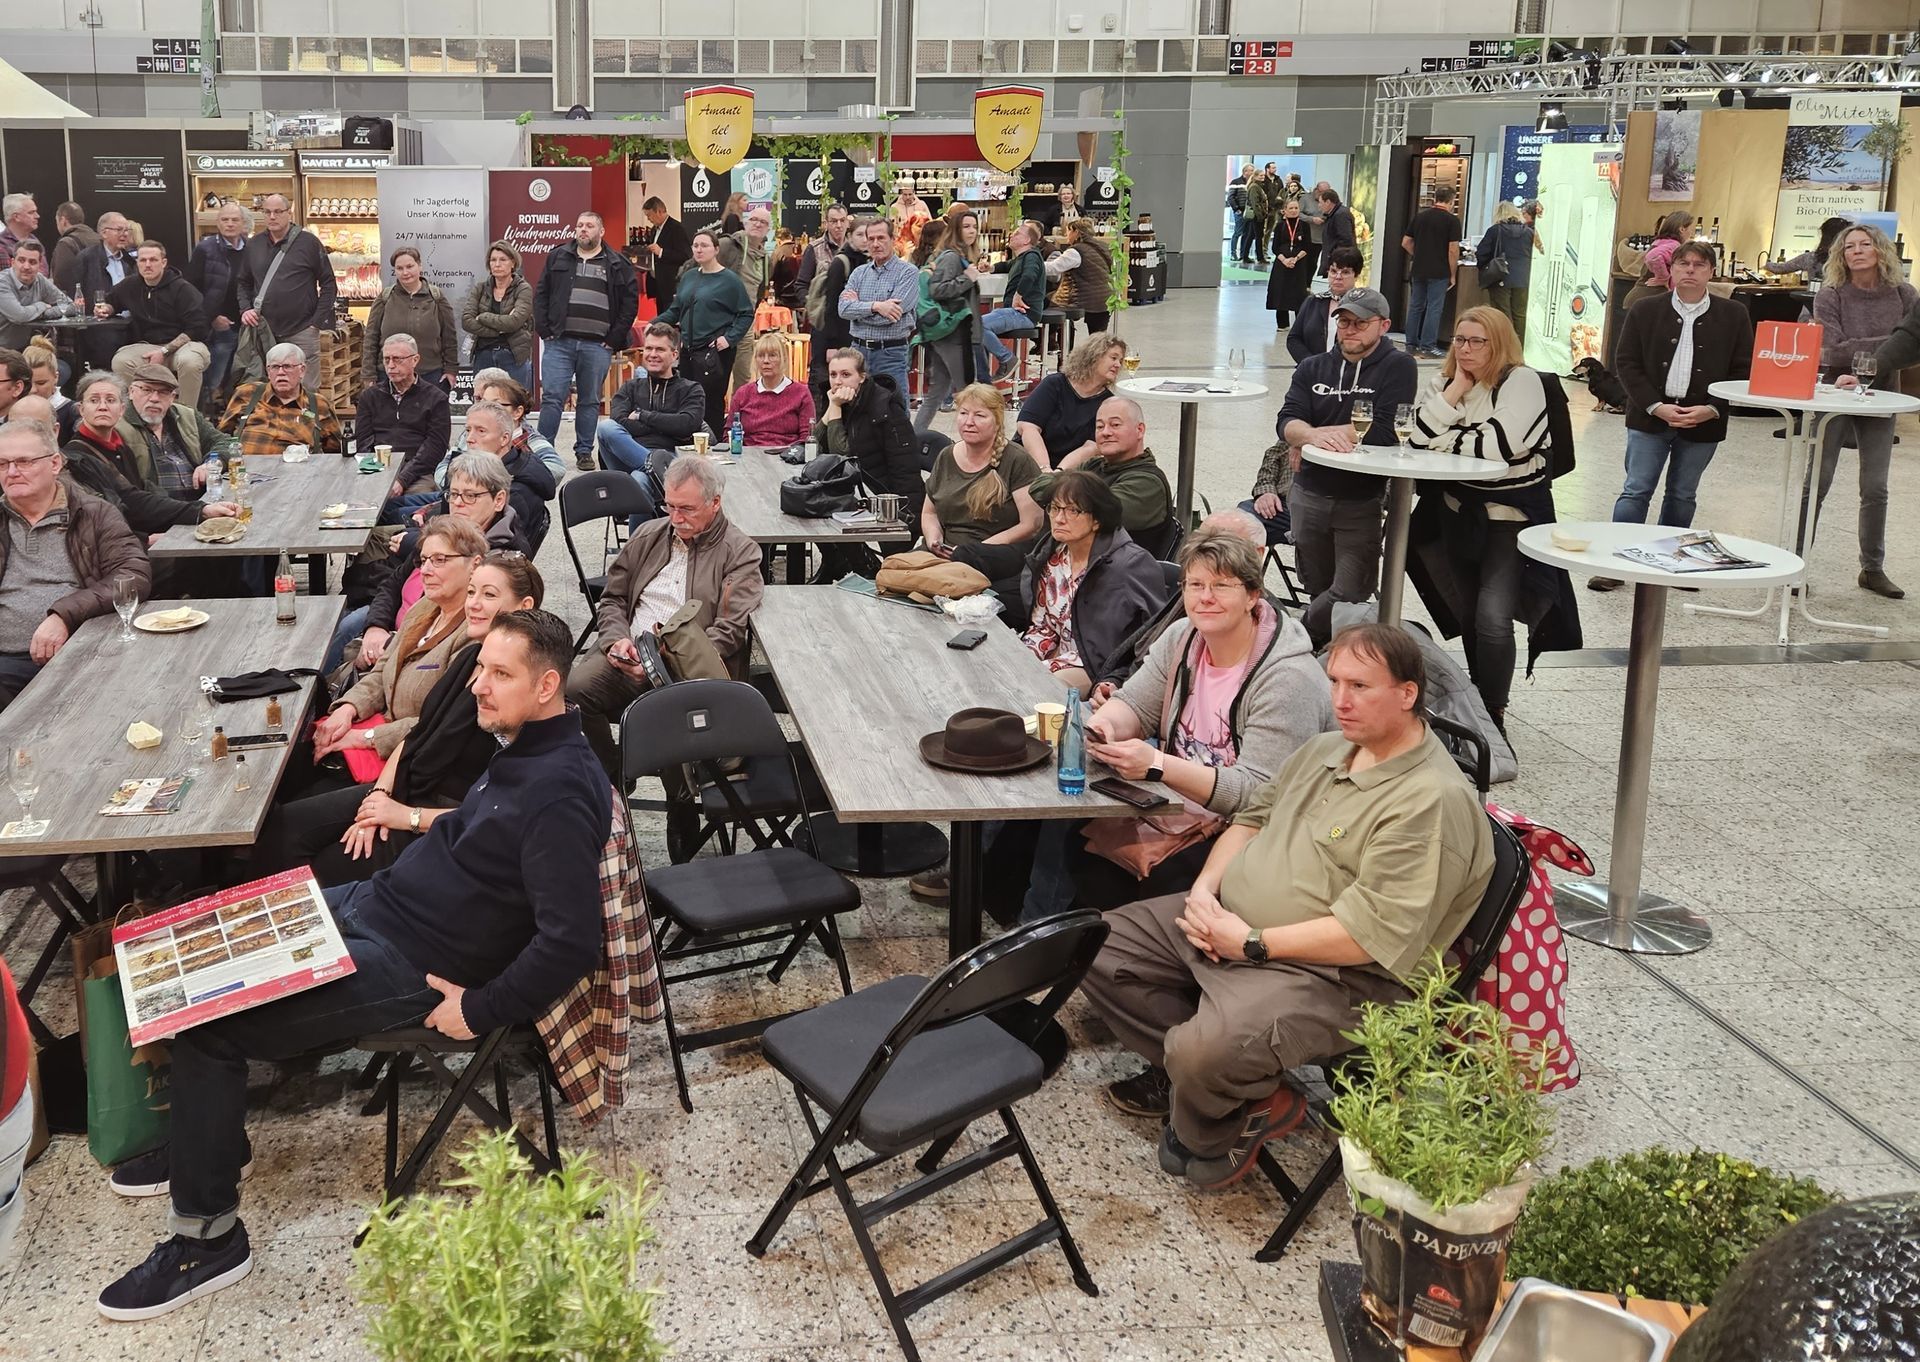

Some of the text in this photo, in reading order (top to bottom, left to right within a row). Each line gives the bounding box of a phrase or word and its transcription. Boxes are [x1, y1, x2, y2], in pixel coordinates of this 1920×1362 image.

[1249, 43, 1258, 56] 1
[1247, 60, 1273, 74] 2-8
[698, 103, 743, 116] Amanti
[988, 103, 1033, 117] Amanti
[711, 124, 730, 136] del
[1000, 124, 1020, 135] del
[1518, 135, 1554, 144] UNSERE
[706, 142, 732, 156] Vino
[995, 142, 1020, 155] Vino
[1516, 146, 1542, 155] GENU
[216, 158, 285, 168] BONKHOFF'S
[302, 159, 343, 168] DAVERT
[413, 197, 470, 208] Ihr Jagderfolg
[1797, 193, 1865, 205] Extra natives
[406, 210, 477, 218] Unser Know-How
[518, 214, 560, 224] ROTWEIN
[395, 232, 468, 241] 24/7 Wildannahme
[432, 270, 475, 278] Verpacken,
[1757, 349, 1810, 362] Blaser
